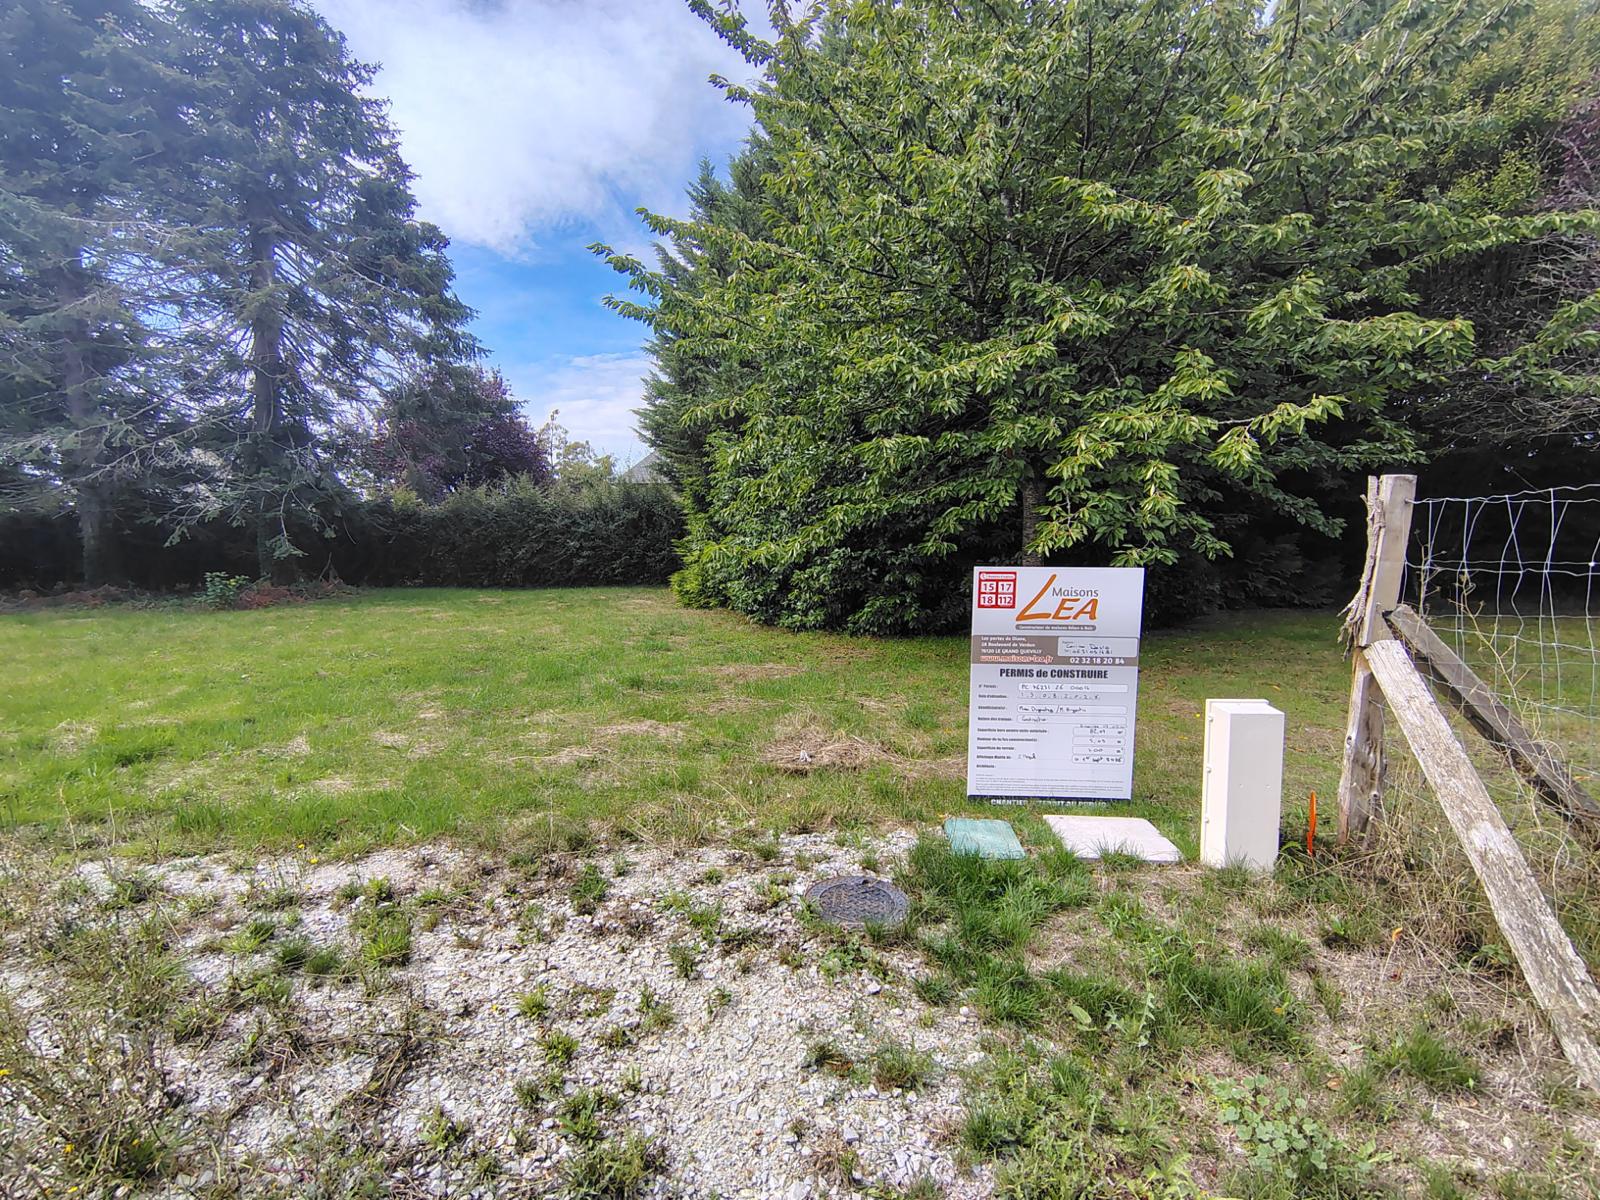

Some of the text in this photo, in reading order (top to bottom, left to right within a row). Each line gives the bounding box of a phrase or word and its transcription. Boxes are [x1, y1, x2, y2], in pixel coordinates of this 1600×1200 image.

[983, 583, 1012, 591] 15 17
[1052, 586, 1099, 597] Maisons
[982, 596, 1013, 604] 18 112
[1016, 573, 1099, 621] LEA
[1000, 669, 1108, 679] PERMIS de CONSTRUIRE
